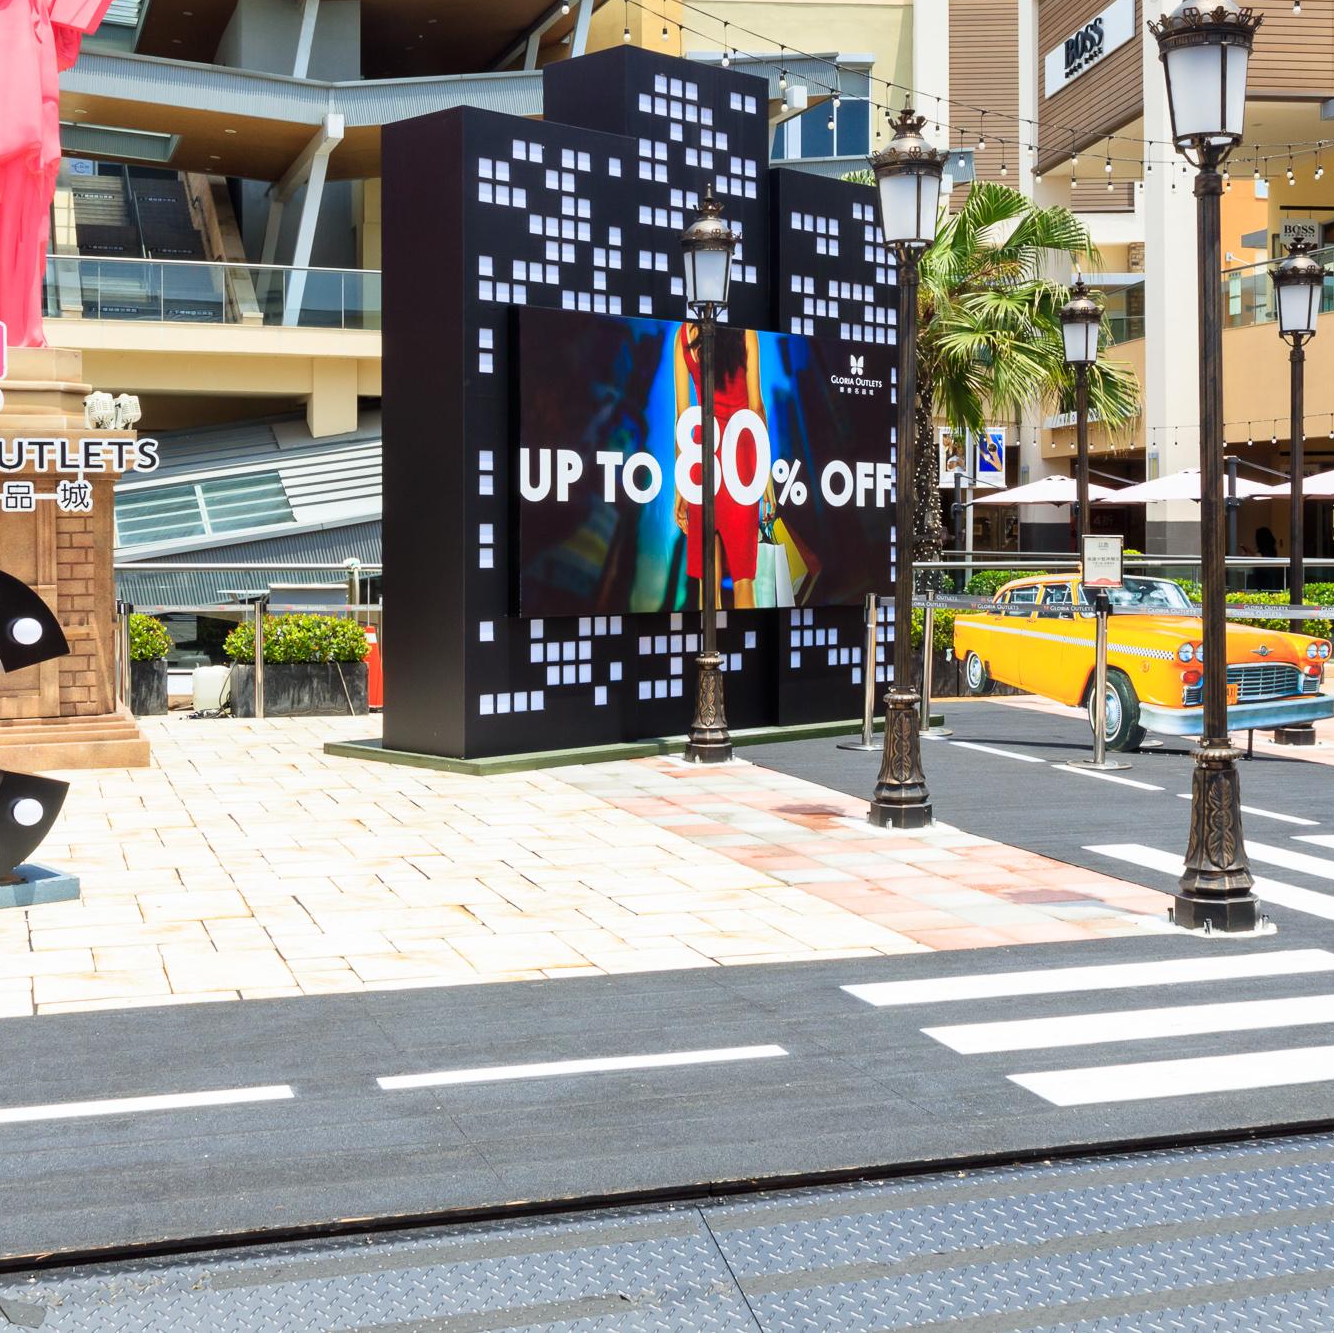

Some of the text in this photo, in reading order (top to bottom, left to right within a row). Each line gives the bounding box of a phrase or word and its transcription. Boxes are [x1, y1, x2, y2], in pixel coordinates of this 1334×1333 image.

[1064, 17, 1105, 70] BOSS
[1284, 224, 1315, 235] BOSS
[830, 374, 883, 389] GLORIA OUTLETS
[519, 447, 584, 503] UP
[596, 450, 663, 505] TO
[820, 459, 893, 509] OFF
